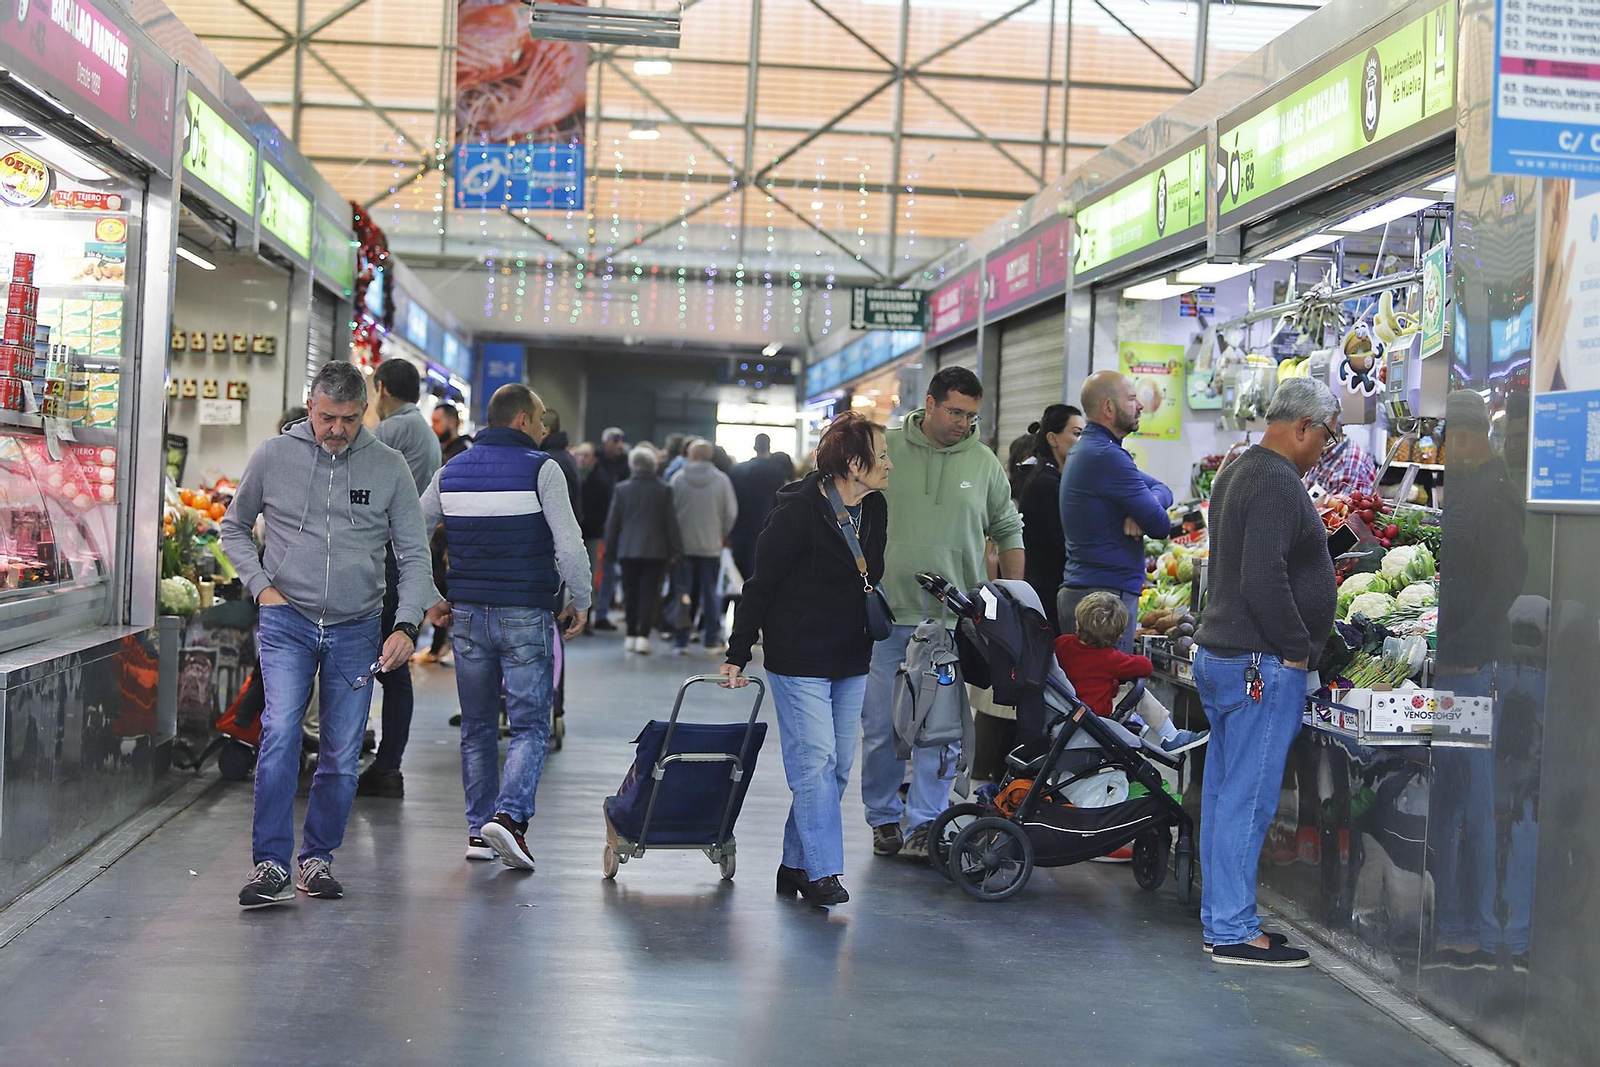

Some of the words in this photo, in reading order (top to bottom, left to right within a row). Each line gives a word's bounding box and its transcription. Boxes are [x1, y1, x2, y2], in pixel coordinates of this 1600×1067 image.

[1526, 15, 1563, 27] Frutas
[51, 0, 92, 48] BACALAO
[92, 19, 129, 79] NARVÁEZ
[1525, 29, 1558, 40] Frutas
[1525, 42, 1558, 53] Frutas
[77, 61, 90, 89] Desde
[1383, 50, 1422, 86] Ayuntamiento
[1393, 84, 1400, 103] de
[1402, 75, 1421, 99] Huelva
[1305, 77, 1350, 132] CRUZADO
[5, 157, 44, 181] ORTIZ
[78, 192, 102, 202] TEJERO
